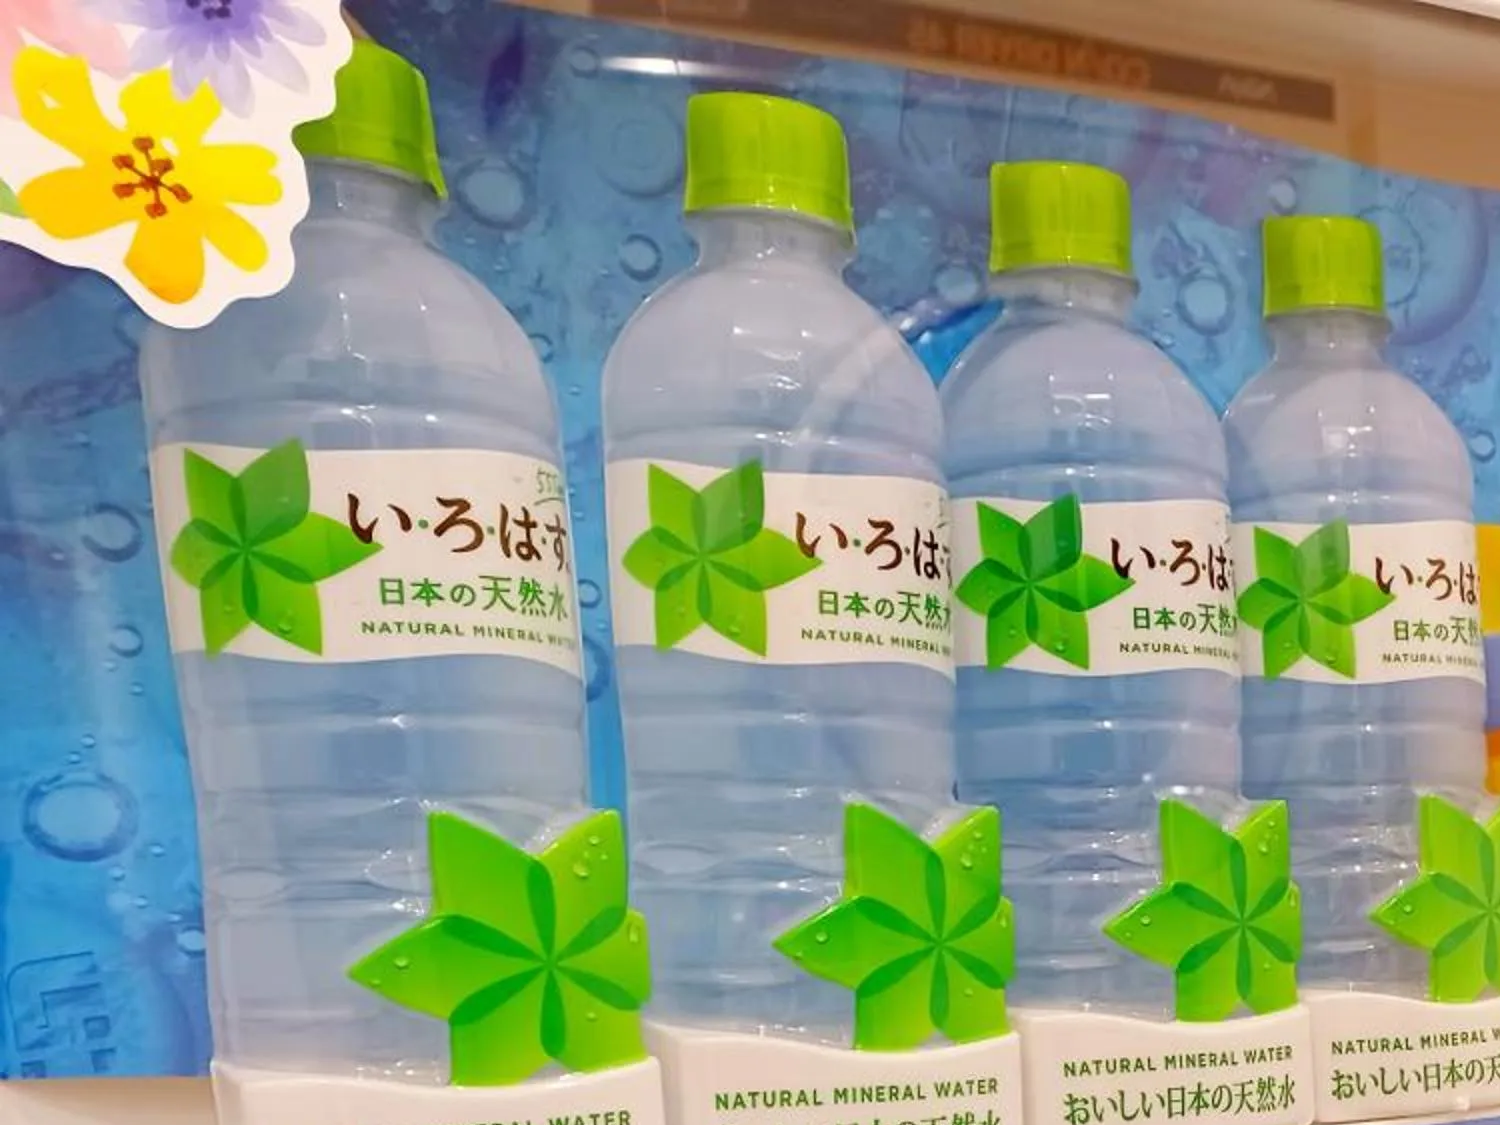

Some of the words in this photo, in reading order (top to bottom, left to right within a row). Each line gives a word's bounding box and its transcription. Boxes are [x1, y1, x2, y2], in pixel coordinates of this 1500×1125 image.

[379, 575, 570, 621] 日本の天然水
[361, 620, 464, 638] NATURAL
[473, 624, 543, 643] MINERAL
[801, 627, 884, 645] NATURAL
[1120, 642, 1189, 655] NATURAL
[1331, 1037, 1415, 1055] NATURAL
[1420, 1030, 1488, 1049] MINERAL
[1063, 1057, 1158, 1078] NATURAL
[1163, 1051, 1239, 1071] MINERAL
[1243, 1045, 1293, 1065] WATER
[714, 1088, 824, 1112] NATURAL
[832, 1083, 927, 1105] MINERAL
[933, 1077, 999, 1098] WATER
